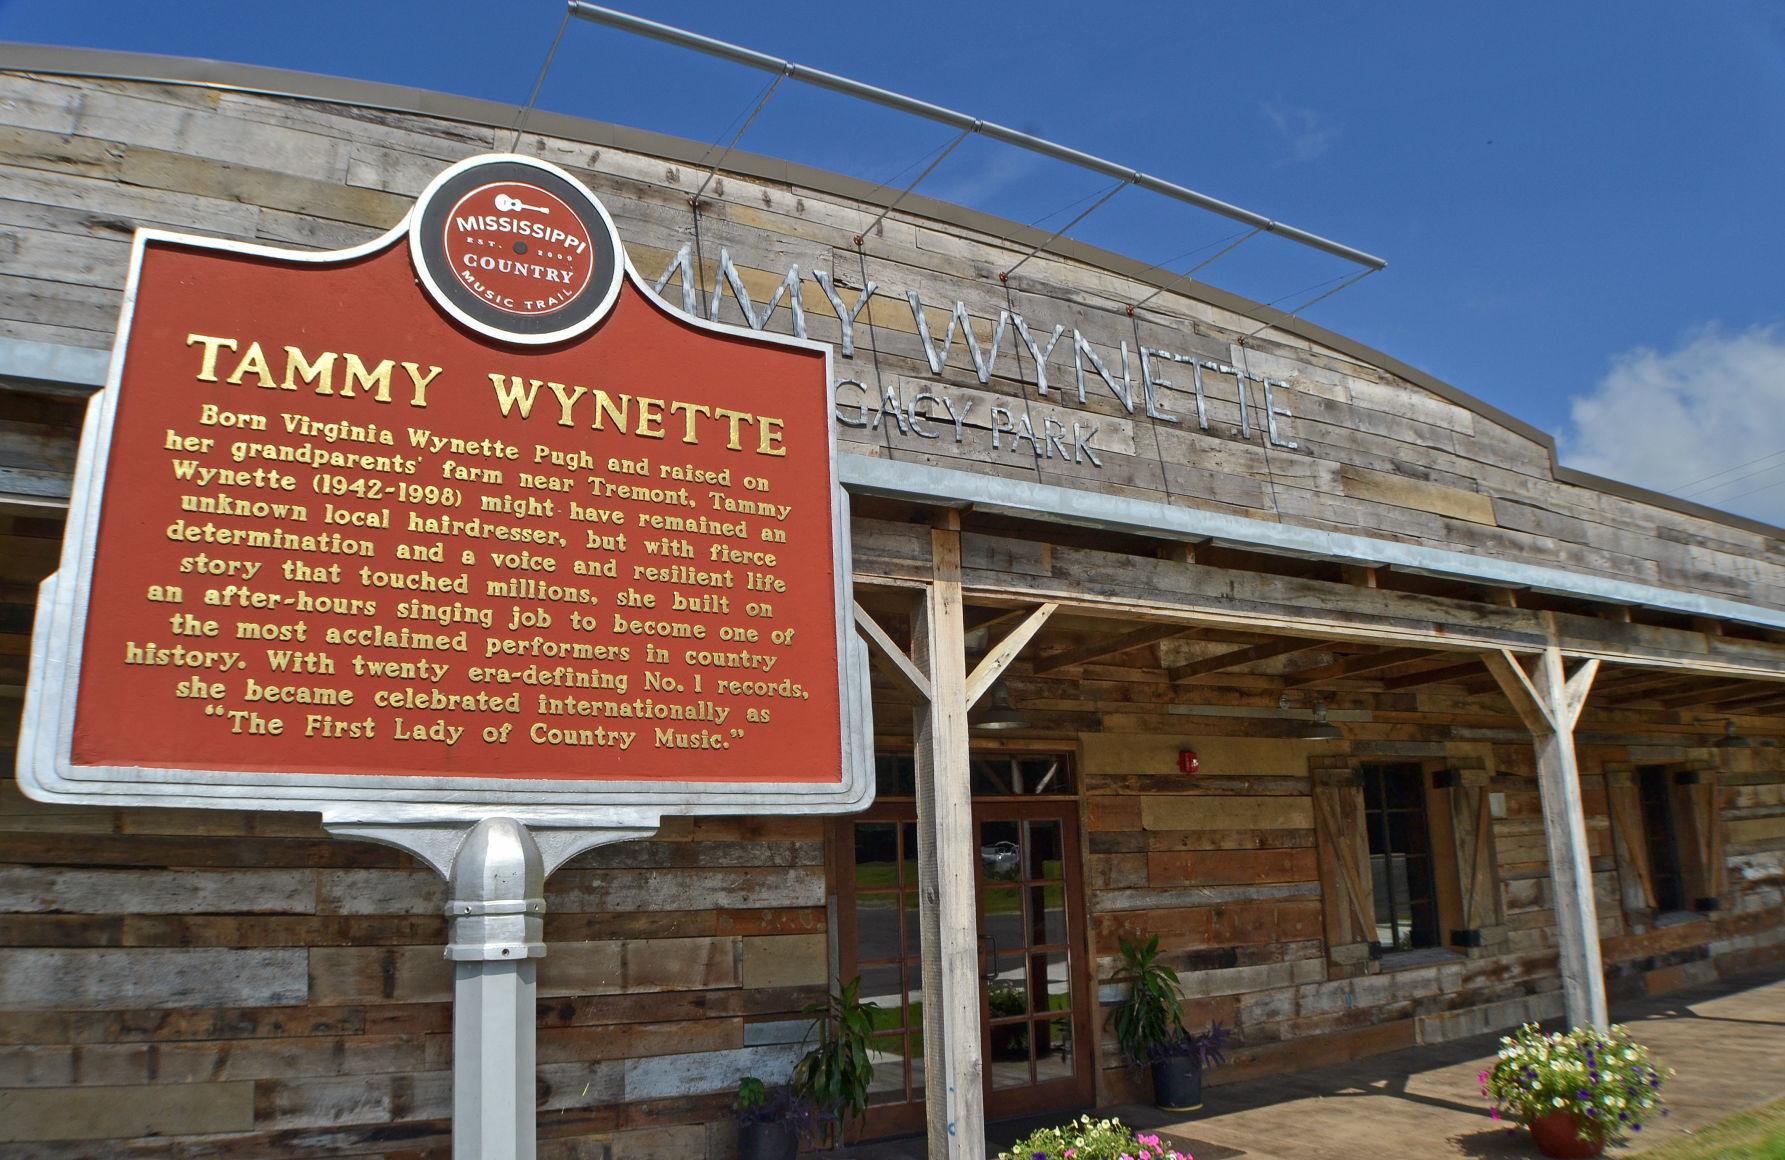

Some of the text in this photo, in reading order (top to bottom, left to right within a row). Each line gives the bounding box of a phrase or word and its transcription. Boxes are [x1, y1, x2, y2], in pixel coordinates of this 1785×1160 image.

[456, 215, 586, 255] MISSISSIPPI
[466, 237, 503, 249] EST.
[461, 270, 573, 310] MUSIC TRAIL
[463, 253, 574, 285] COUNTRY
[185, 332, 787, 456] TAMMY WYNETTE
[907, 290, 1298, 450] WYNETTE
[198, 403, 770, 492] Born Virginia Wynette Pugh and raised on
[991, 405, 1103, 467] PARK
[163, 428, 216, 453] her
[441, 459, 504, 485] farm
[518, 472, 575, 492] near
[587, 475, 697, 508] Tremont,
[708, 491, 792, 521] Tammy
[171, 458, 297, 491] Wynette
[480, 494, 555, 519] might
[569, 501, 625, 525] have
[638, 513, 748, 539] remained
[760, 527, 787, 543] an
[166, 519, 787, 593] determination and a voice and resilient life
[180, 492, 777, 567] unknown local hairdresser, but with fierce
[146, 584, 796, 646] an after-hours singing job to become one of
[179, 552, 774, 618] story that touched millions, she built on
[124, 641, 247, 672] history.
[265, 649, 336, 675] With
[351, 654, 450, 682] twenty
[467, 664, 629, 695] era-defining
[643, 670, 685, 692] No.
[717, 678, 809, 700] records,
[168, 612, 778, 672] the most acclaimed performers in country
[175, 675, 771, 725] she became celebrated internationally as
[304, 714, 376, 738] First
[393, 717, 465, 745] Lady
[482, 722, 513, 743] of
[529, 722, 637, 750] Country
